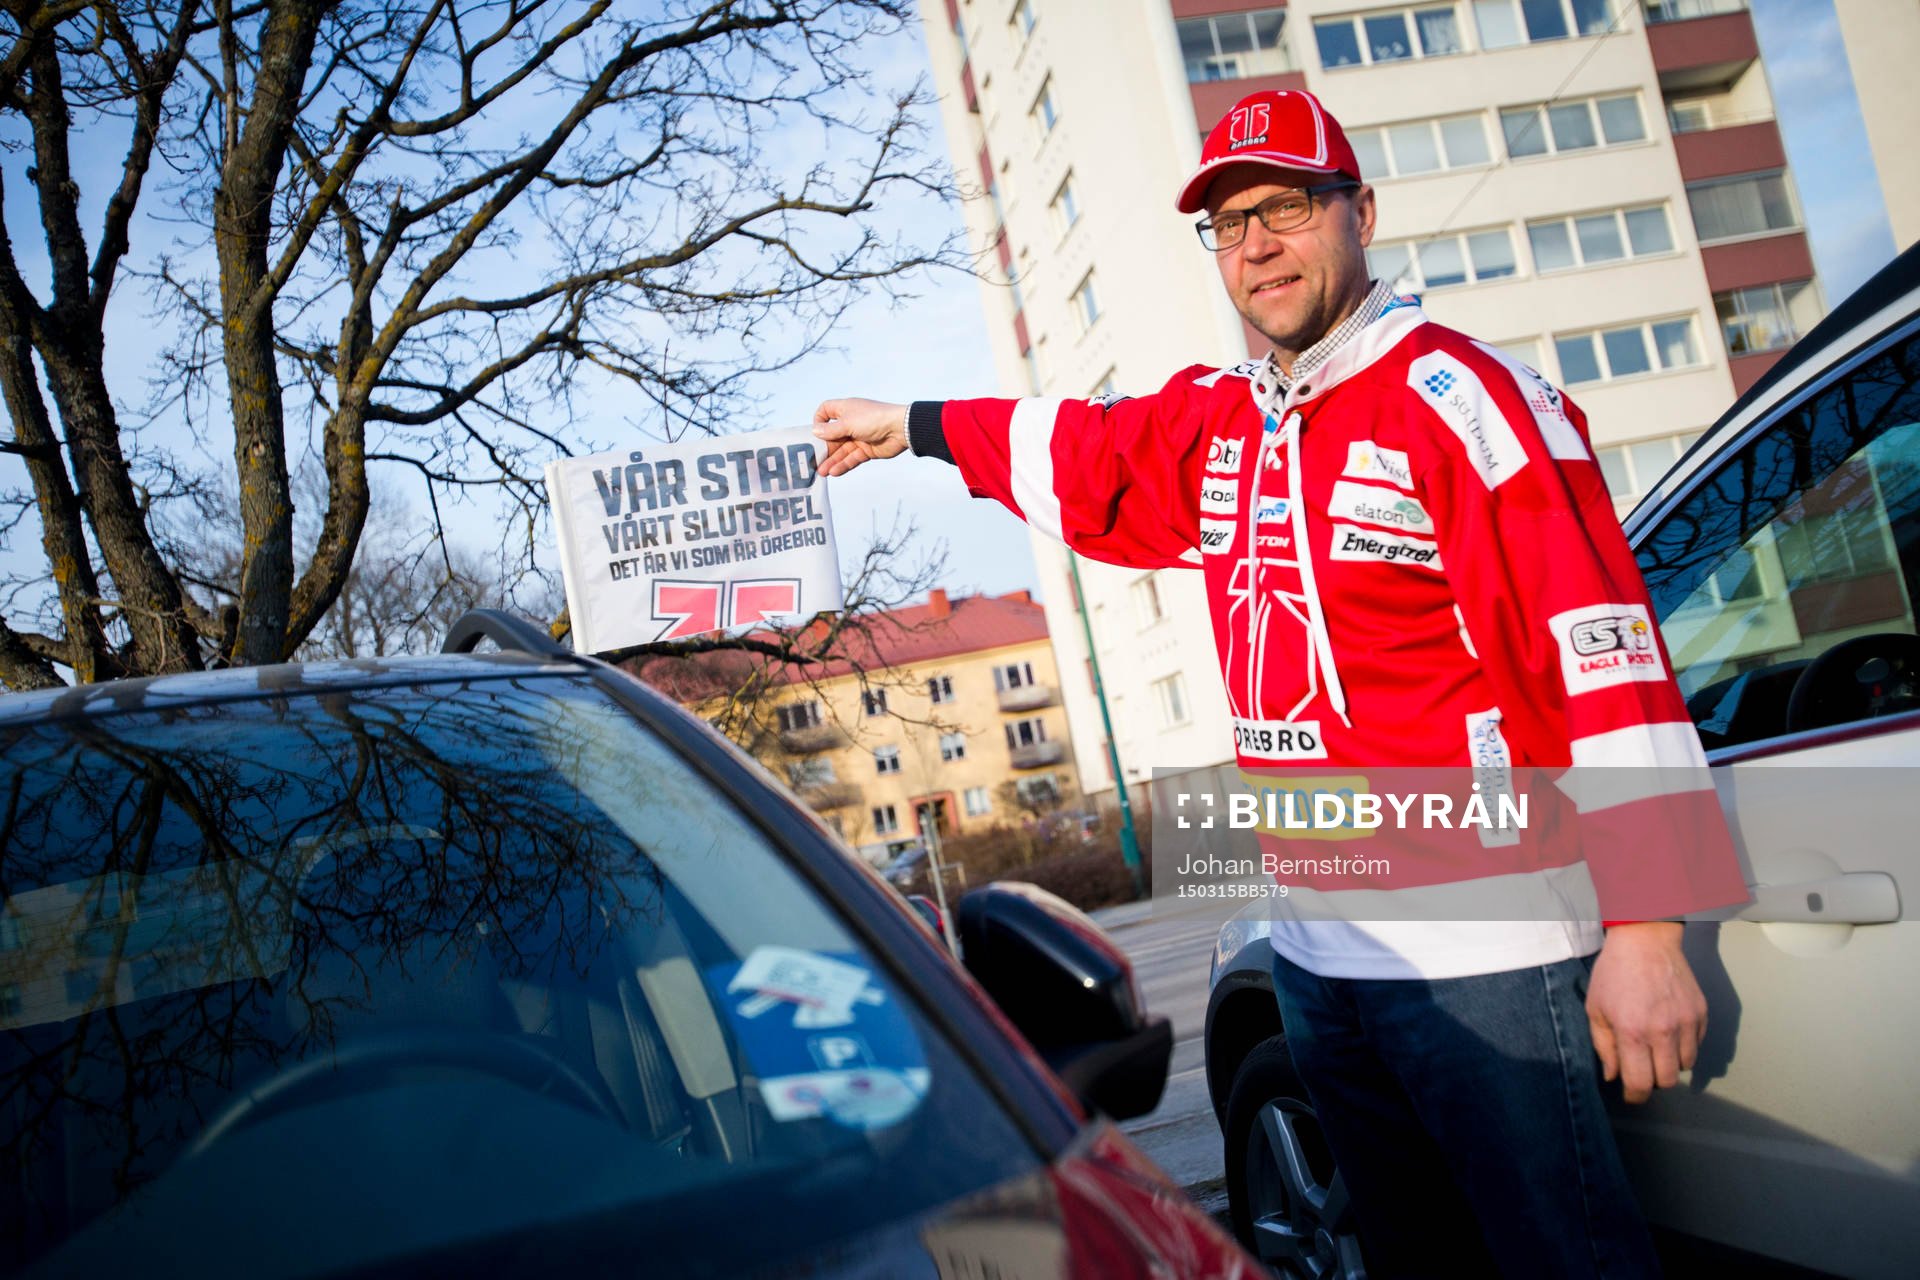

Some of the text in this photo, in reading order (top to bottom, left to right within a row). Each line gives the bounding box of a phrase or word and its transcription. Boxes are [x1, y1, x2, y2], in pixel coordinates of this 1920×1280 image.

[592, 442, 817, 518] VÅR STAD
[601, 495, 823, 554] VÅRT SLUTSPEL
[1354, 503, 1405, 525] elaton
[609, 526, 827, 581] DET ÄR VI SOM ÄR ÖREBRO
[1341, 532, 1439, 562] Energizer
